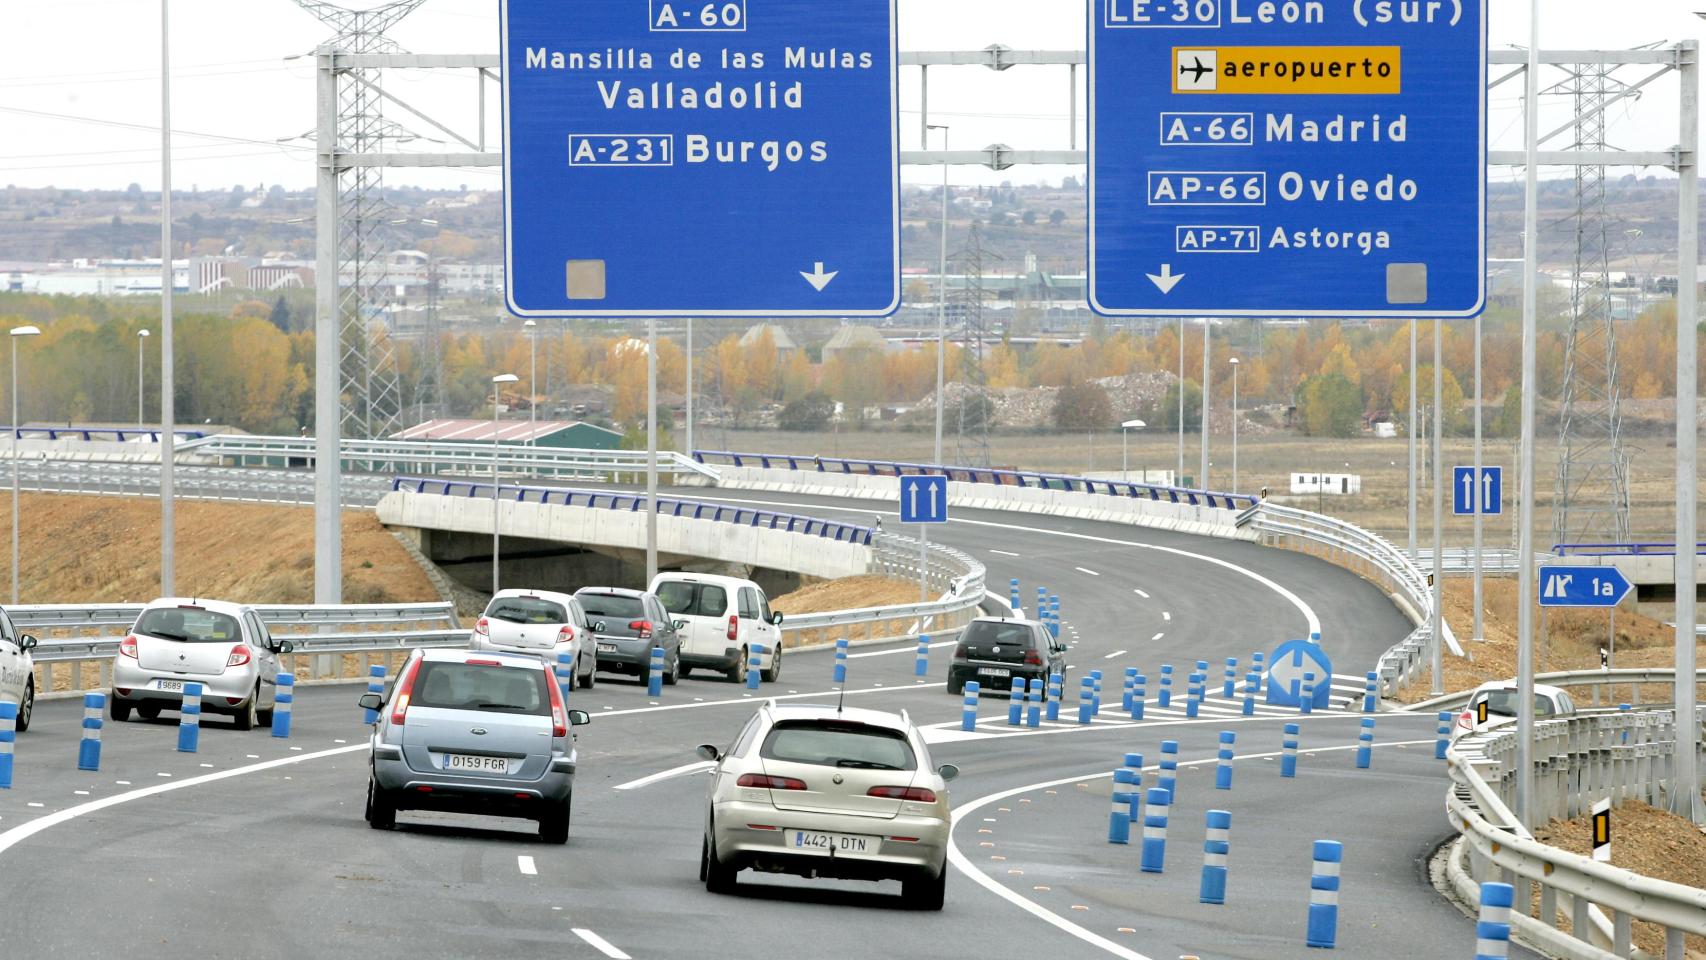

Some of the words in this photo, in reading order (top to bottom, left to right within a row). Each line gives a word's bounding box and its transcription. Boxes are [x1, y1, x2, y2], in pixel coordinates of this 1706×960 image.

[656, 3, 741, 27] A-60
[1110, 0, 1215, 22] LE-30
[1353, 0, 1462, 27] (sur)
[526, 47, 652, 69] Mansilla
[669, 48, 702, 69] de
[721, 48, 764, 69] las
[784, 47, 873, 69] Mulas
[1223, 59, 1391, 82] aeropuerto
[596, 80, 802, 109] Valladolid
[1166, 118, 1248, 141] A-66
[1266, 114, 1407, 142] Madrid
[573, 139, 669, 162] A-231
[686, 134, 828, 172] Burgos
[1154, 177, 1261, 200] AP-66
[1278, 171, 1417, 201] Oviedo
[1181, 230, 1256, 248] AP-71
[1268, 226, 1390, 256] Astorga
[1592, 577, 1614, 596] 1a
[163, 681, 182, 690] 9689
[452, 756, 481, 768] 0159
[483, 758, 505, 770] FGR
[803, 834, 834, 848] 4421
[841, 837, 866, 851] DTN
